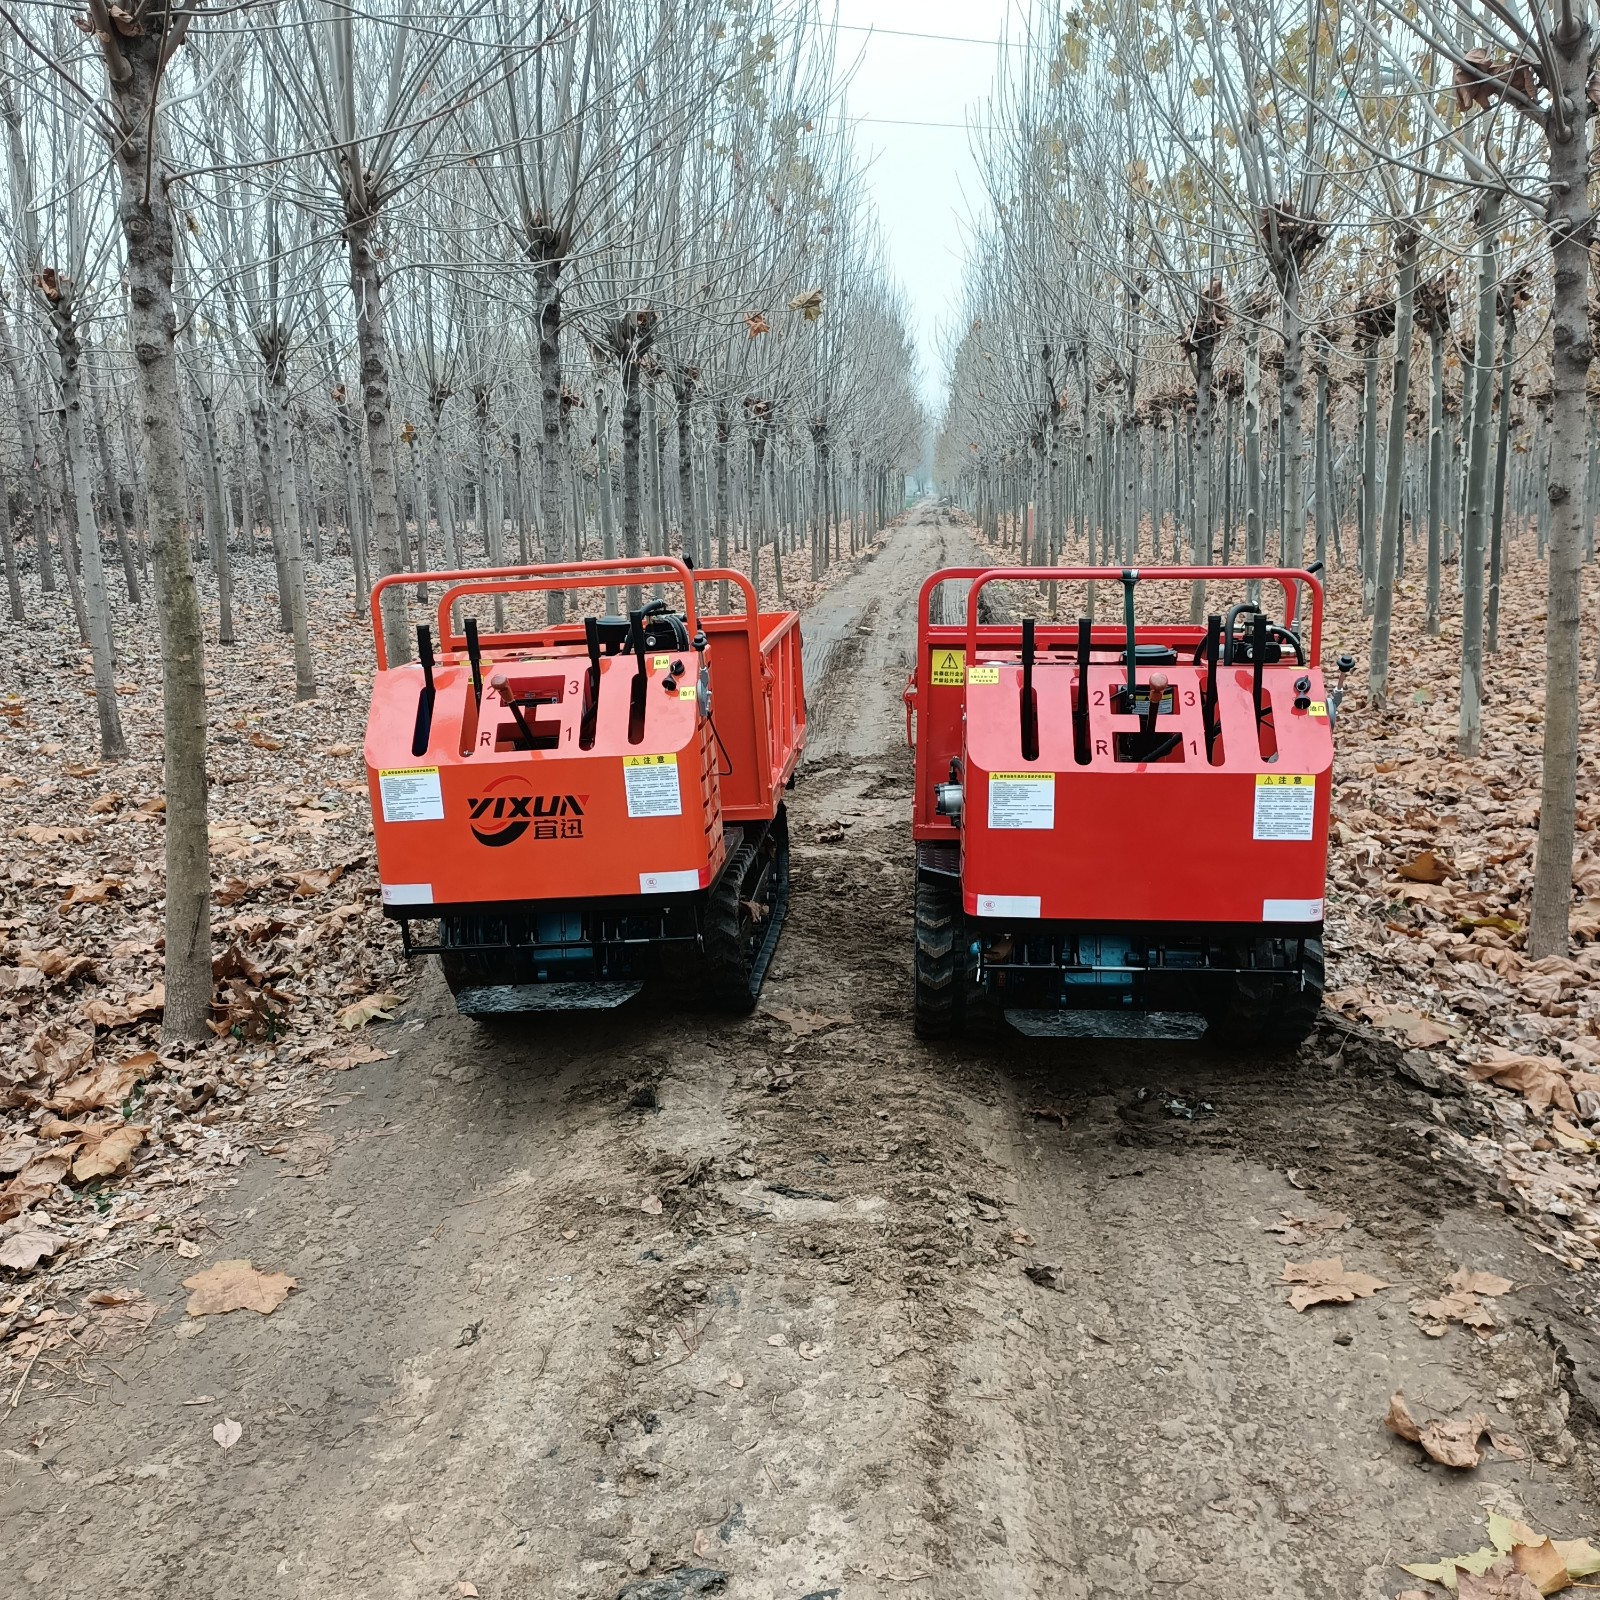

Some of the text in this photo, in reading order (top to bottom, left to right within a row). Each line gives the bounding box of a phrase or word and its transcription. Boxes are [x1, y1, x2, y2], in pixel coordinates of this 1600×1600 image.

[486, 685, 497, 700] 2
[568, 680, 580, 695] 3
[1092, 690, 1105, 706] 2
[1183, 691, 1196, 707] 3
[480, 731, 492, 747] R
[565, 726, 572, 742] 1
[1096, 739, 1109, 756] R
[1189, 740, 1198, 756] 1
[643, 755, 665, 764] 注意
[1278, 776, 1303, 785] 注意
[466, 794, 590, 820] YIXUN
[533, 818, 584, 840] 宜迅
